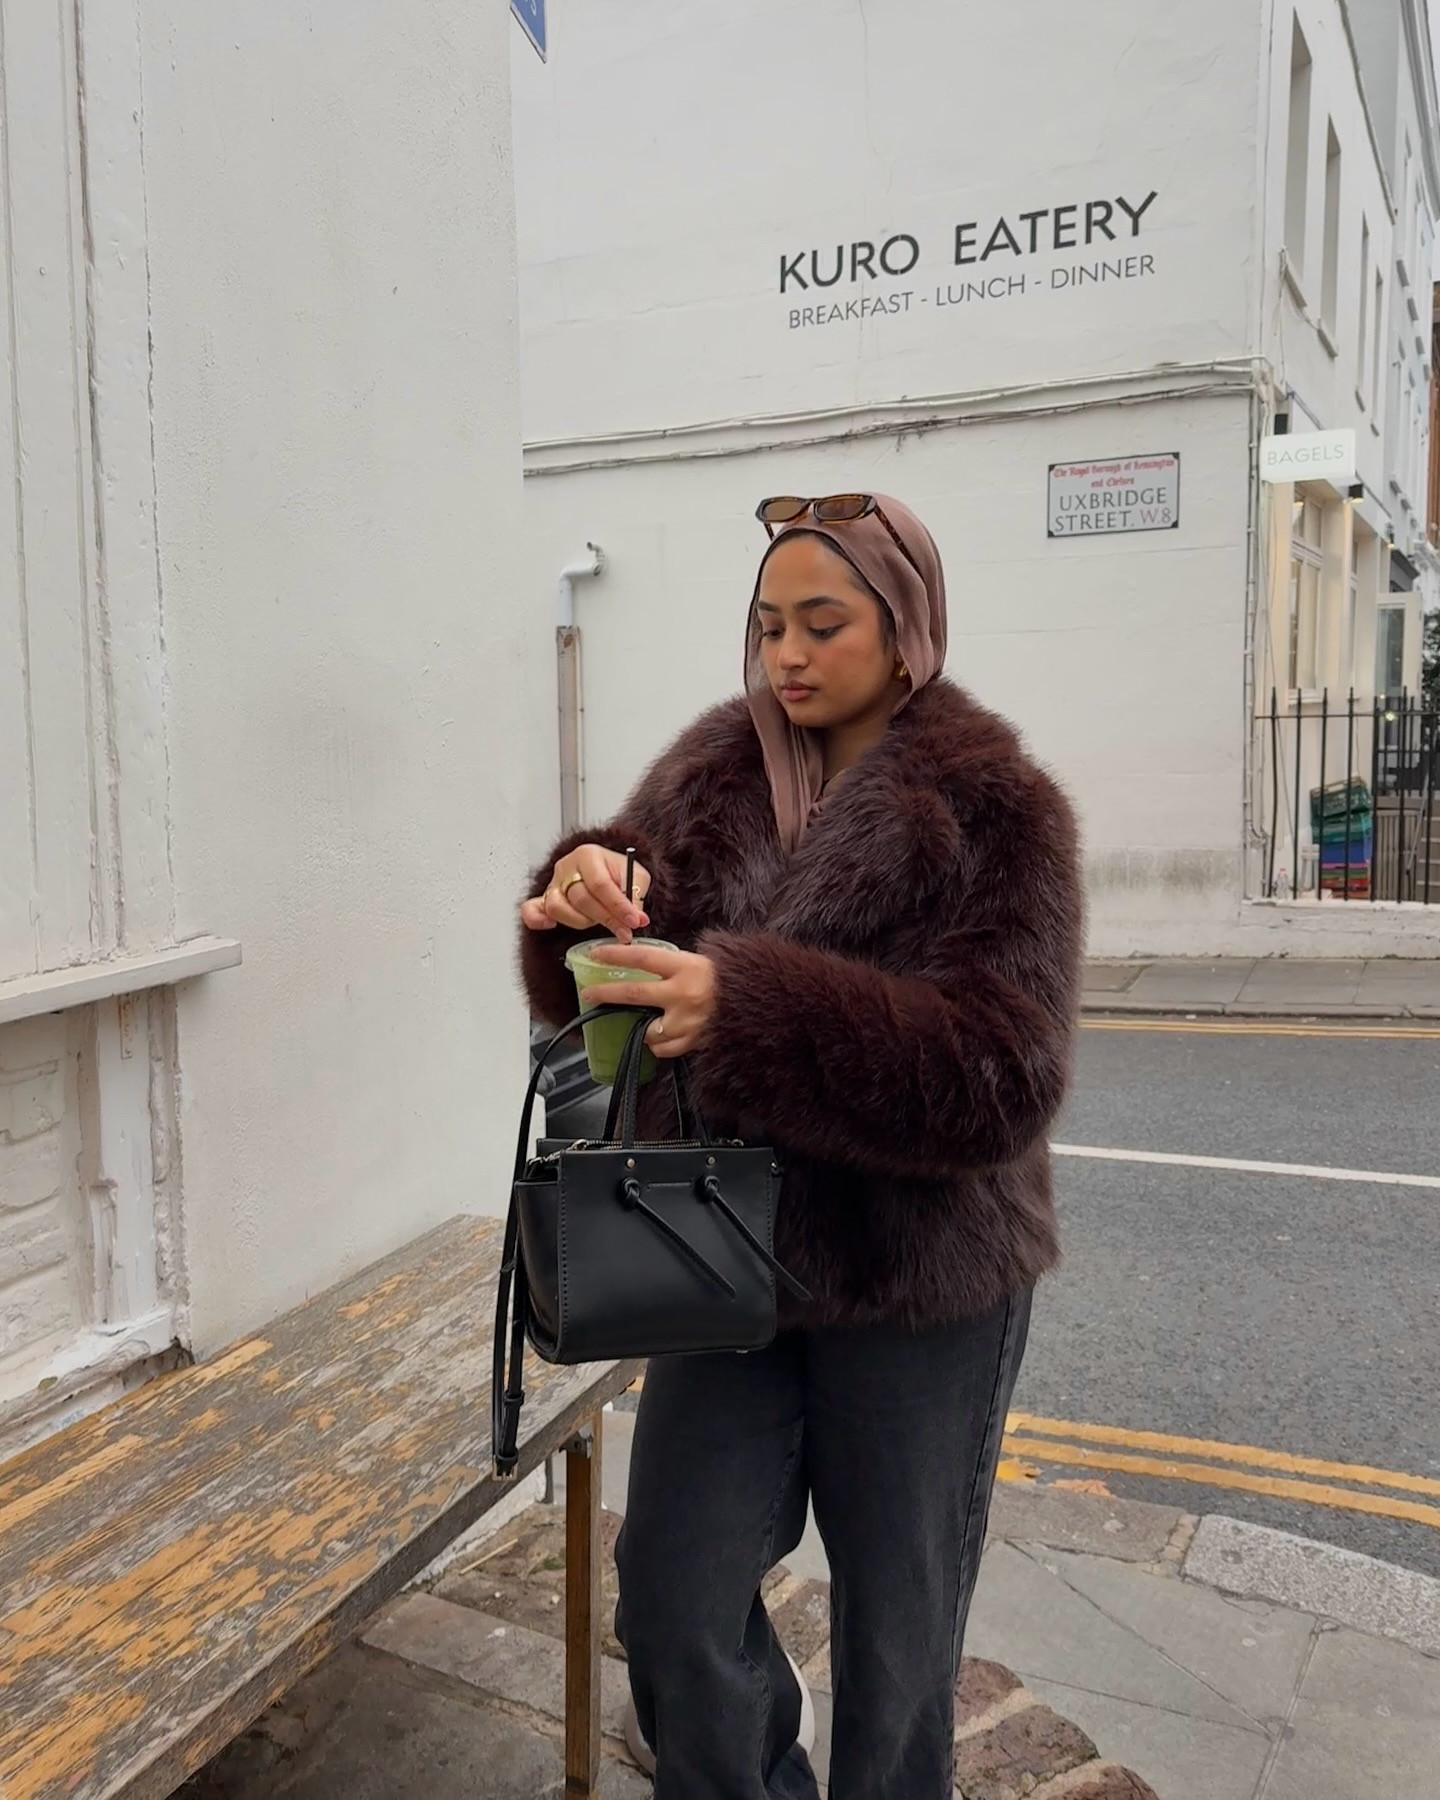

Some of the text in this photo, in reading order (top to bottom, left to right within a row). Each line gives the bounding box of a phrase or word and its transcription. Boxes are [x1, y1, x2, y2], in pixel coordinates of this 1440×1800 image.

[780, 191, 1158, 293] KURO EATERY
[789, 292, 914, 329] BREAKFAST
[936, 274, 1025, 306] LUNCH
[1051, 255, 1156, 289] DINNER
[1267, 444, 1344, 466] BAGELS
[1060, 487, 1167, 511] UXBRIDGE
